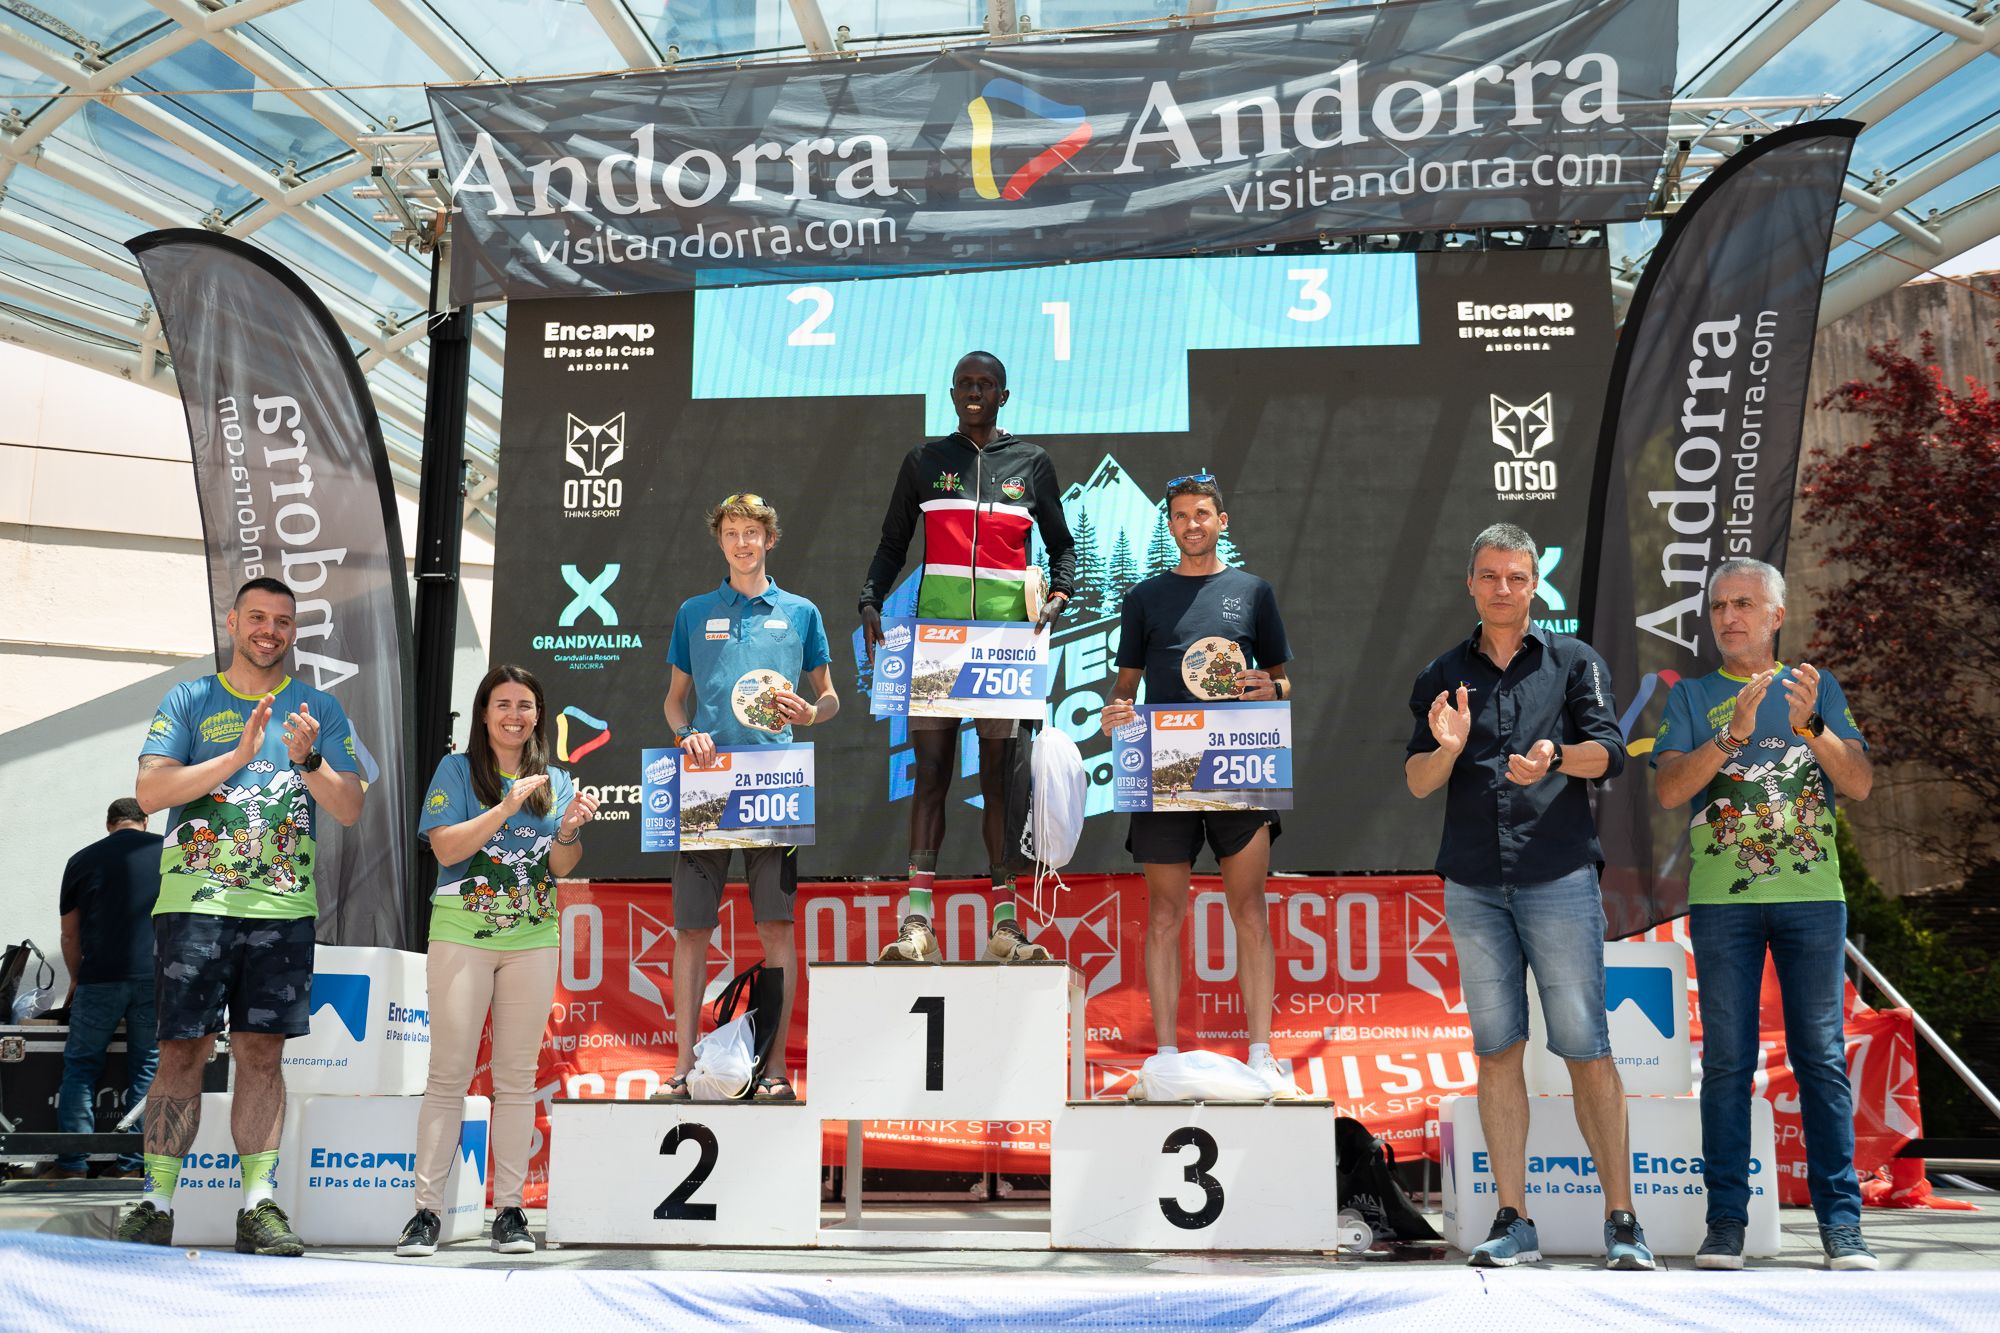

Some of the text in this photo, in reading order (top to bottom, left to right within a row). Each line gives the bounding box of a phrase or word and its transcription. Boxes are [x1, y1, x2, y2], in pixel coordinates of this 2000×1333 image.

[1113, 52, 1626, 175] Andorra
[452, 124, 898, 218] Andorra
[1223, 153, 1622, 213] visitandorra.com
[533, 216, 897, 266] visitandorra.com
[1285, 268, 1332, 323] 3
[786, 286, 836, 347] 2
[1457, 301, 1574, 321] Encamp
[544, 322, 655, 342] Encamp
[1041, 301, 1071, 361] 1
[1458, 325, 1575, 338] El Pas de la Casa
[543, 345, 655, 358] El Pas de la Casa
[1485, 343, 1550, 351] ANDORRA
[567, 363, 629, 371] ANDORRA
[1721, 310, 1778, 562] isitandorra.com
[1494, 460, 1557, 491] OTSO
[1635, 313, 1741, 657] Andorra
[563, 478, 623, 508] OTSO
[1497, 491, 1555, 500] THINK SPORT
[564, 509, 620, 518] THINK SPORT
[532, 634, 642, 649] GRANDVALIRA
[924, 628, 961, 641] 21K
[988, 646, 1036, 661] POSICIÓ
[971, 667, 1034, 696] 750€
[1160, 713, 1199, 727] 21K
[1208, 728, 1280, 746] 3A POSICIÓ
[735, 768, 804, 787] 2A POSICIÓ
[1212, 754, 1277, 785] 250€
[572, 777, 642, 804] orra
[738, 792, 800, 823] 500€
[552, 1001, 603, 1023] ORT
[1289, 993, 1381, 1014] SPORT
[579, 1033, 626, 1048] BORN
[631, 1033, 647, 1046] IN
[1359, 1026, 1404, 1038] BORN
[1412, 1027, 1429, 1038] IN
[909, 996, 945, 1091] 1
[282, 1057, 348, 1068] w.encamp.ad
[966, 1120, 1051, 1135] SPOR
[864, 1131, 999, 1146] www.otsosport.com
[309, 1177, 416, 1188] El Pas de la Cas
[653, 1123, 719, 1222] 2
[1158, 1126, 1225, 1230] 3
[180, 1178, 240, 1188] Pas de la
[1473, 1182, 1487, 1193] El
[1546, 1182, 1560, 1193] la
[1564, 1182, 1601, 1194] Casa
[1634, 1183, 1647, 1194] El
[1652, 1184, 1679, 1195] Pas
[1683, 1183, 1703, 1195] de
